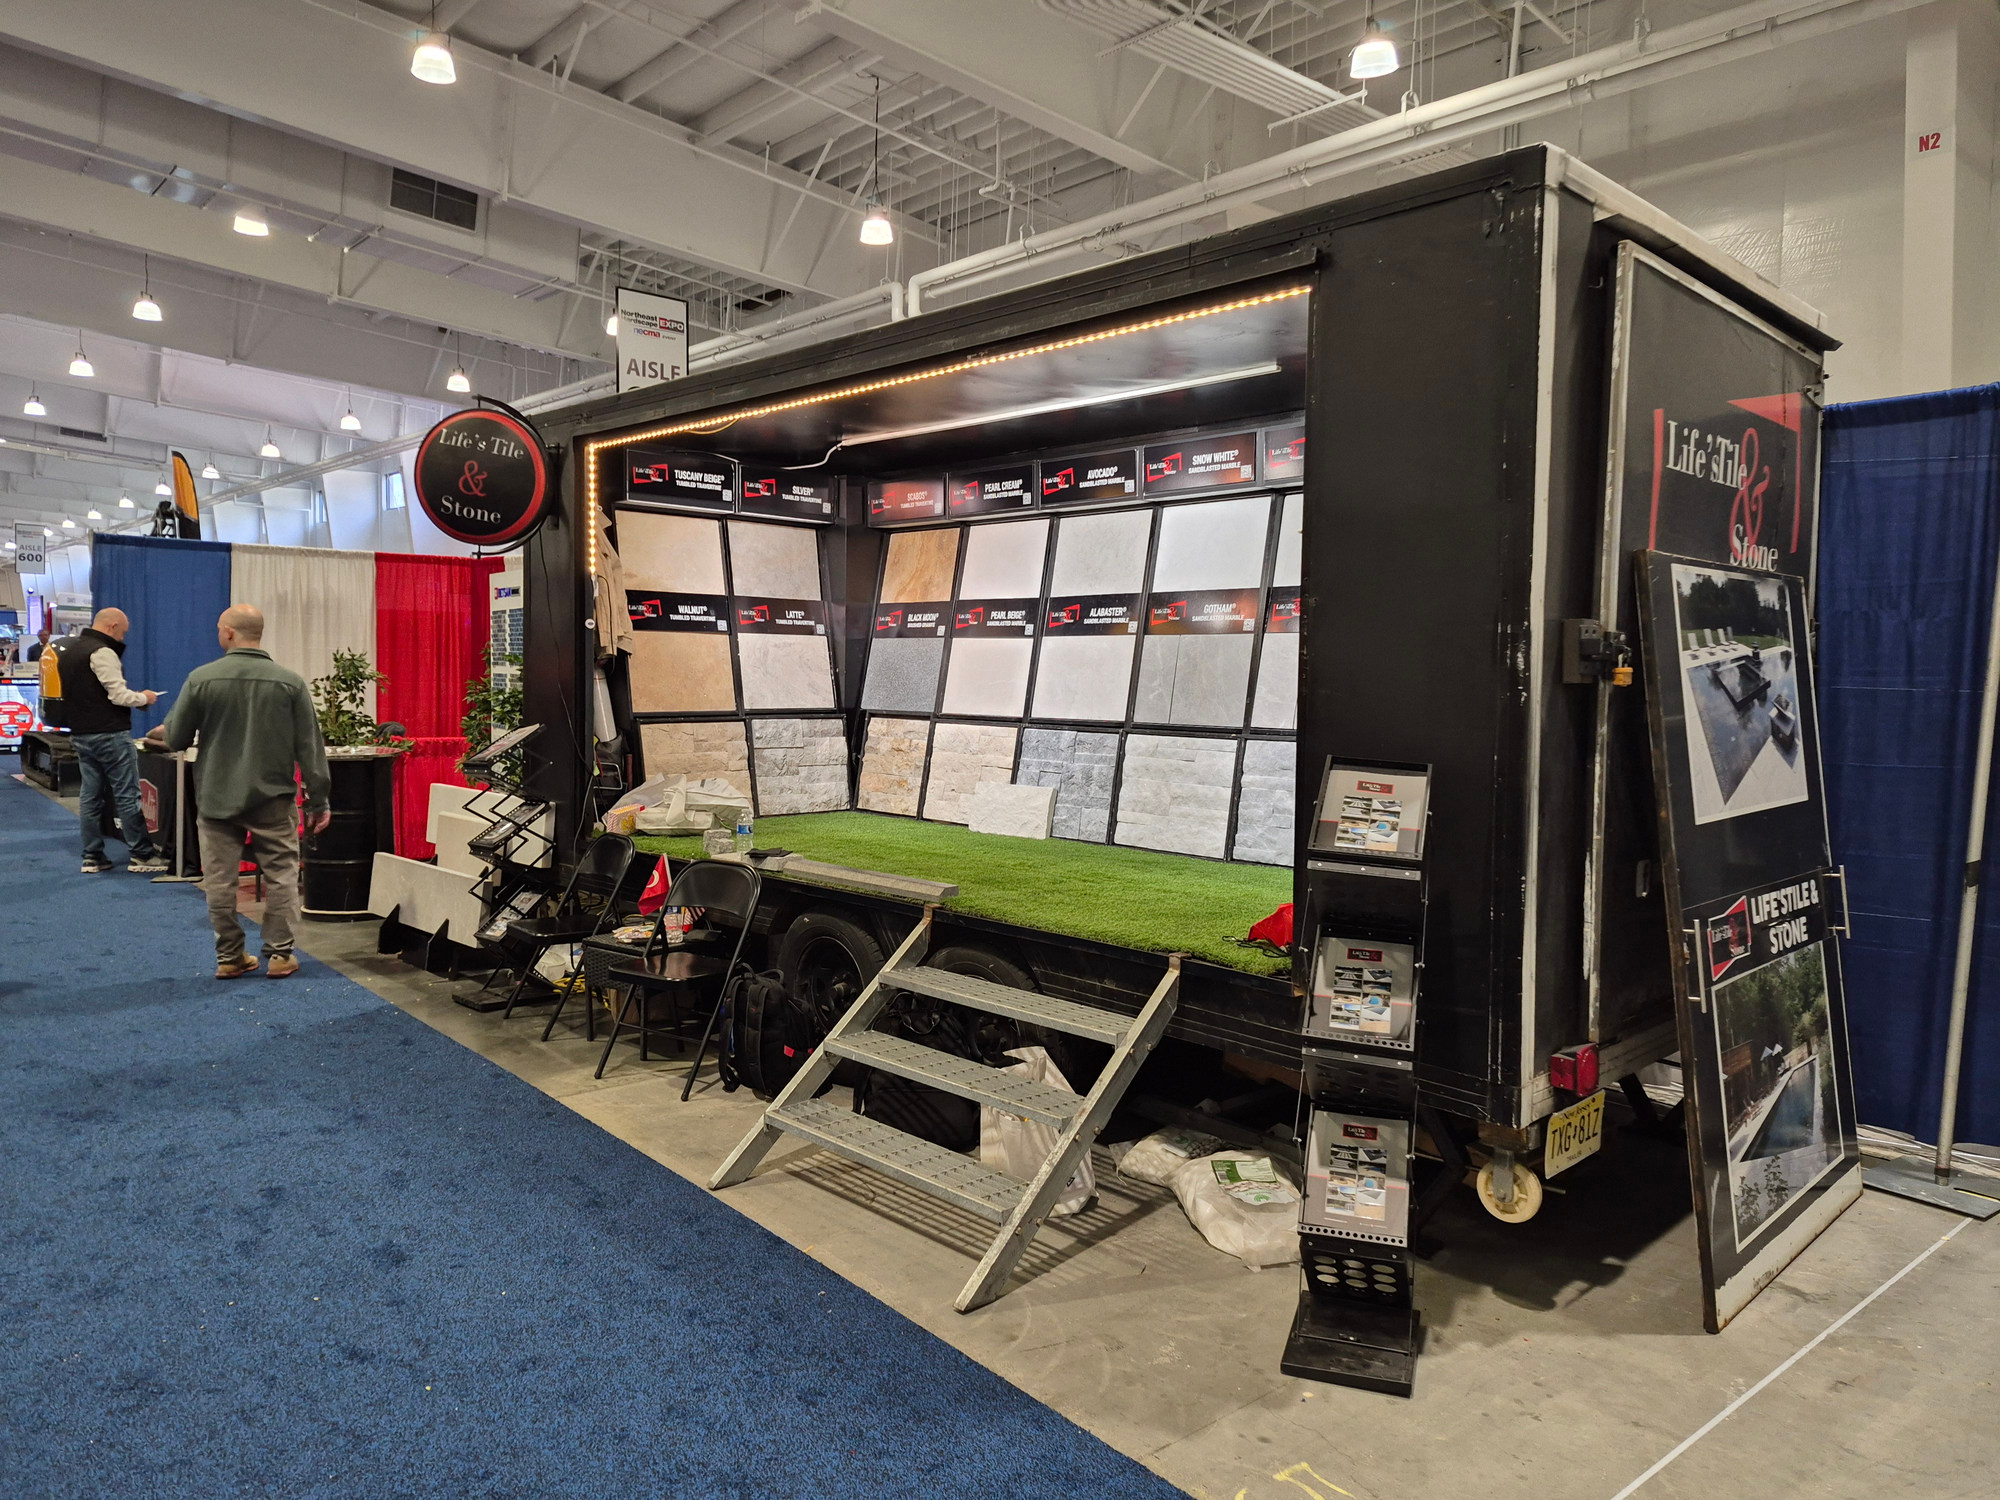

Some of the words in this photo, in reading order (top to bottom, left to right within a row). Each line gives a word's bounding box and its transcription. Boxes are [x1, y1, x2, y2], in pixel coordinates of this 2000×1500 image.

[1919, 132, 1941, 152] N2
[621, 309, 657, 322] Northeast
[660, 319, 684, 331] EXPO
[440, 428, 487, 452] Life's
[491, 437, 524, 460] Tile
[1192, 453, 1213, 466] SNOW
[1188, 464, 1221, 474] SANDBLASTED
[1221, 461, 1241, 470] MARBLE
[459, 460, 488, 497] &
[674, 469, 703, 481] TUSCANY
[985, 482, 1001, 493] PEARL
[441, 495, 501, 524] Stone
[1729, 523, 1778, 571] Stone
[18, 552, 43, 562] 600
[907, 613, 922, 622] BLACK
[990, 611, 1007, 620] PEARL
[1810, 879, 1819, 905] &
[1769, 916, 1809, 954] STONE
